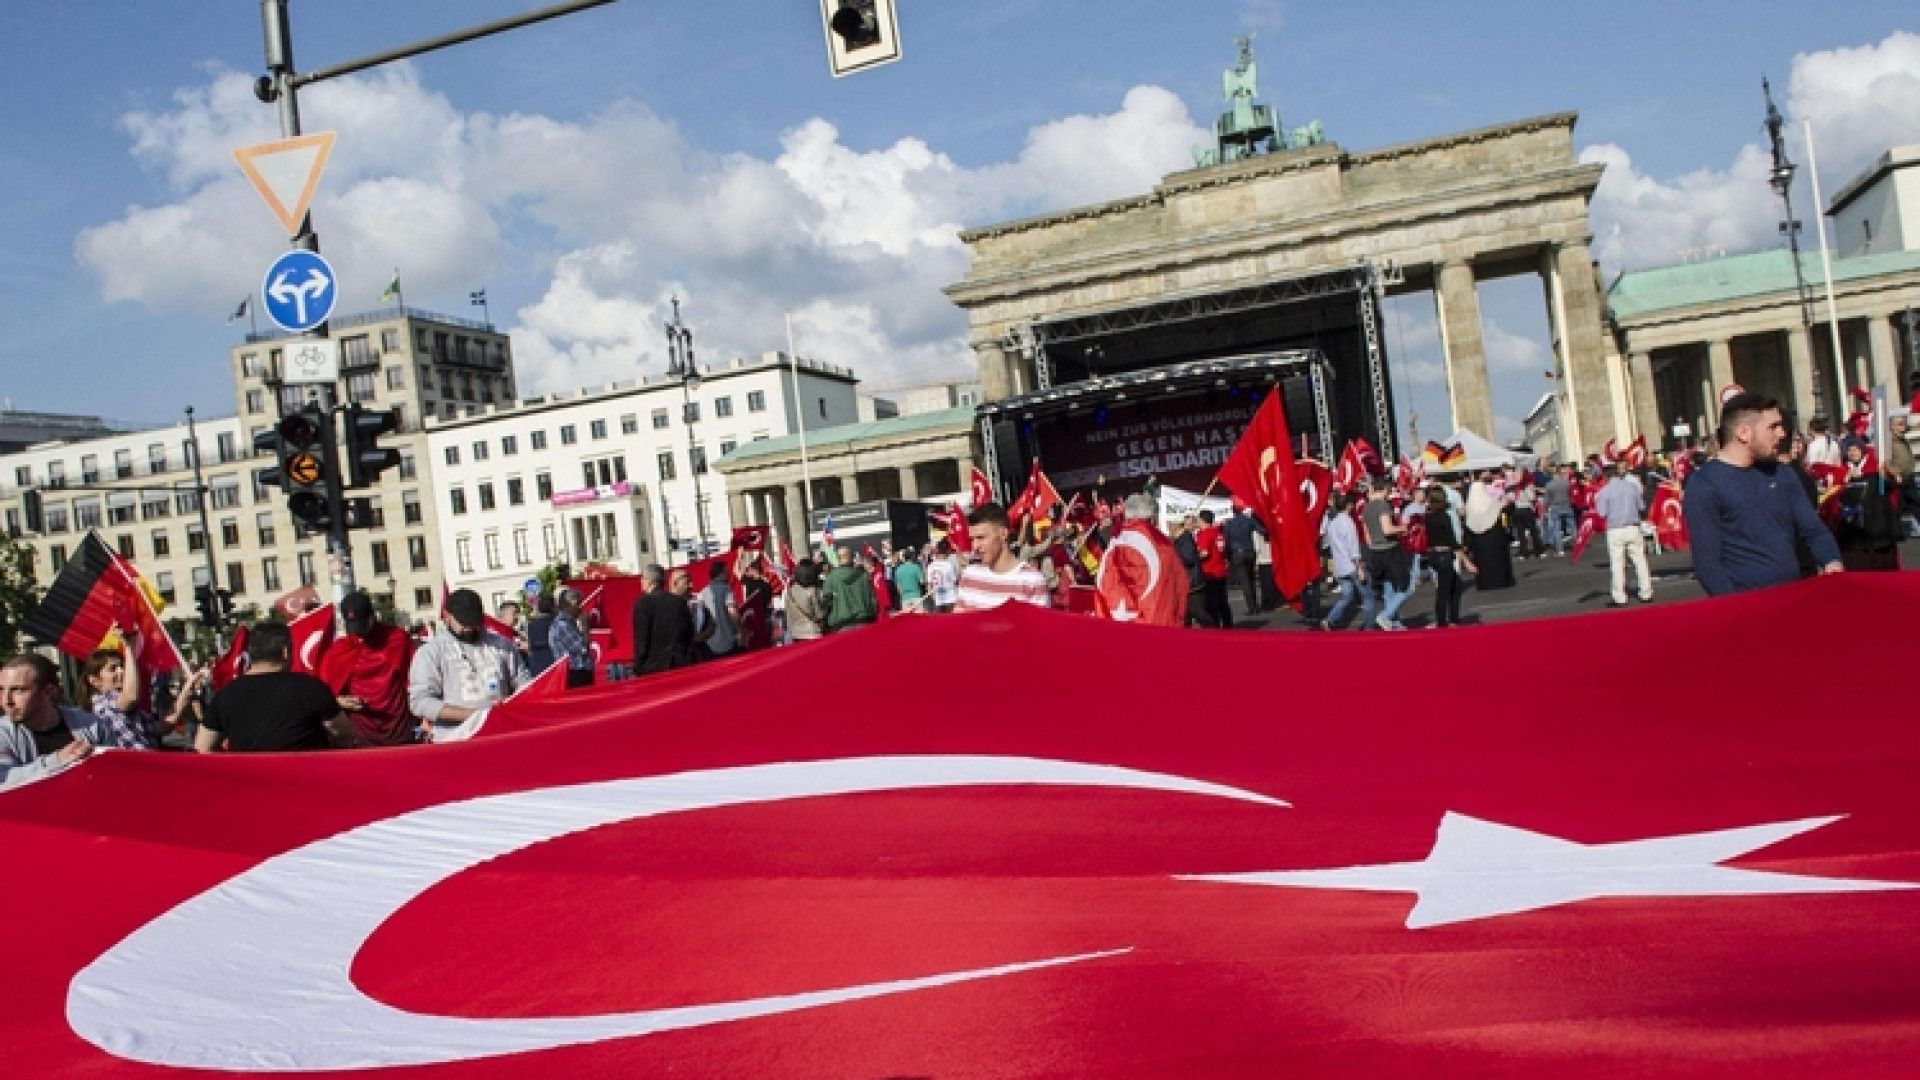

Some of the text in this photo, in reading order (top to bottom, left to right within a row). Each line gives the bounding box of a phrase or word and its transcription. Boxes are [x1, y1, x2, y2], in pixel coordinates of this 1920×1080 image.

[1086, 429, 1118, 443] NEIN
[1122, 423, 1146, 437] ZUR
[1116, 424, 1247, 458] GEGEN HAS
[1127, 445, 1235, 476] SOLIDARIT
